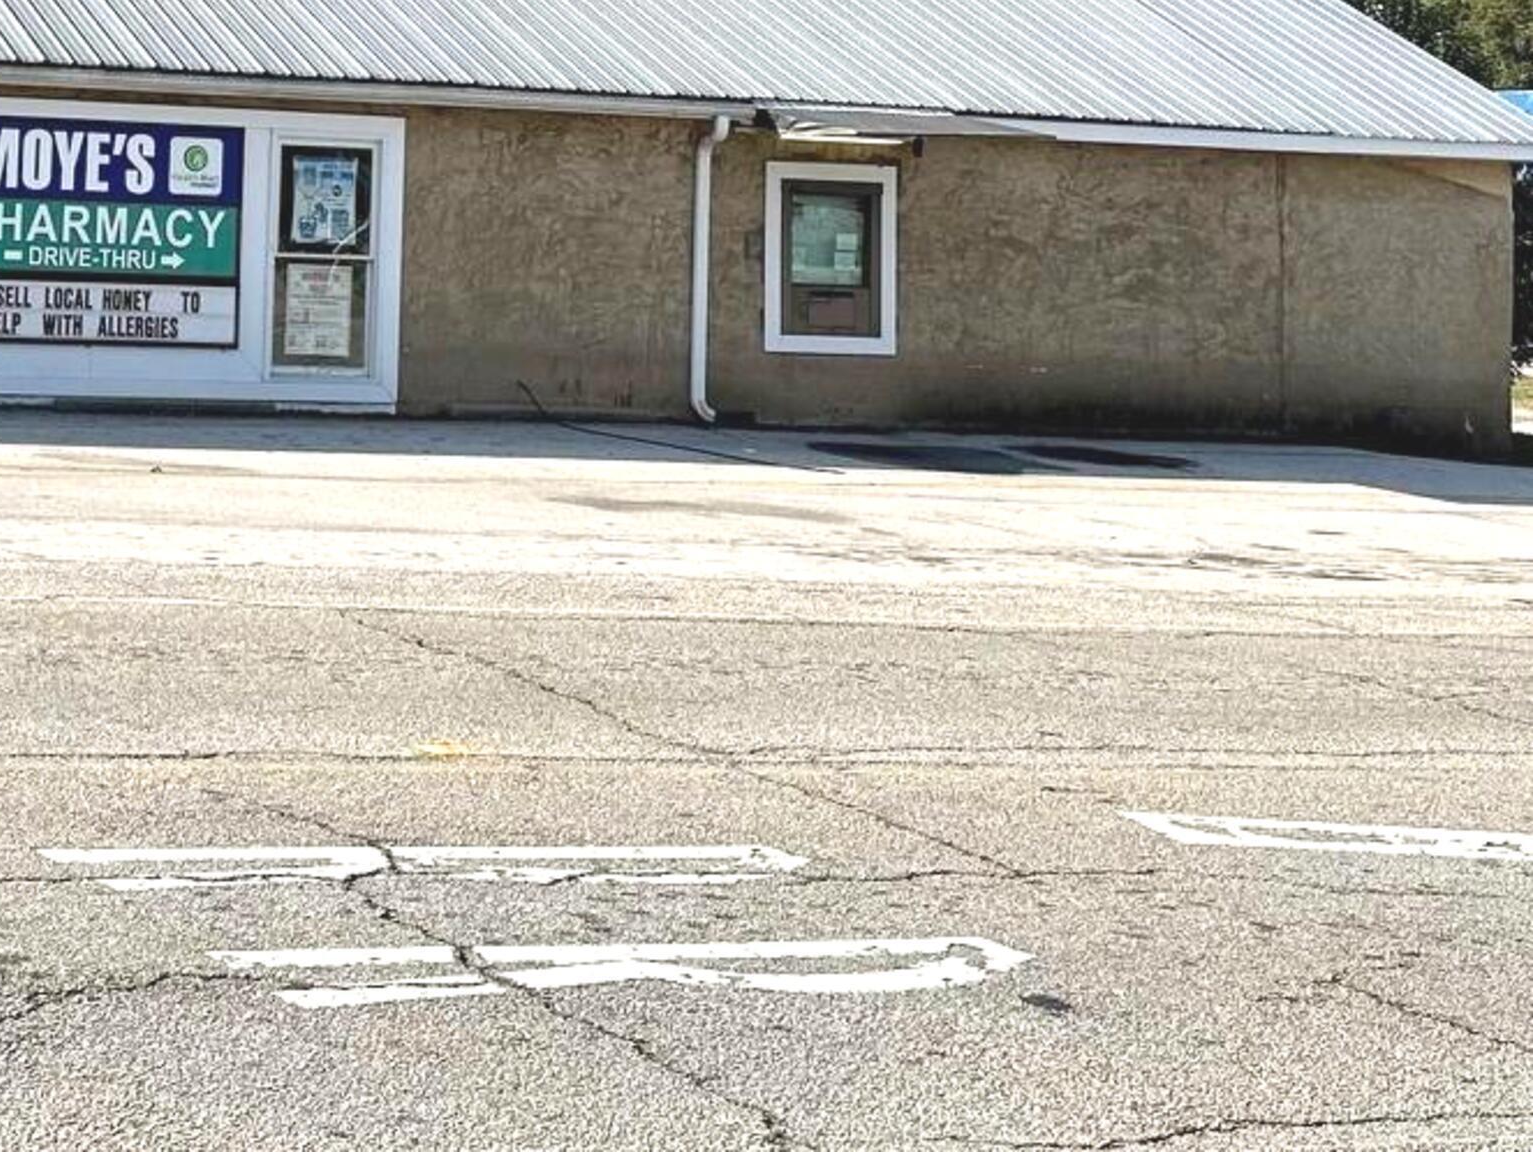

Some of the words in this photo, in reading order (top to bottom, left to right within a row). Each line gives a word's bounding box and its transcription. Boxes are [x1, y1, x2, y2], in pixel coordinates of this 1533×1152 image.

[28, 246, 156, 269] DRIVE-THRU
[44, 287, 93, 310] LOCAL
[102, 289, 152, 312] HONEY
[180, 291, 202, 313] TO
[42, 314, 83, 336] WITH
[97, 315, 179, 339] ALLERGIES
